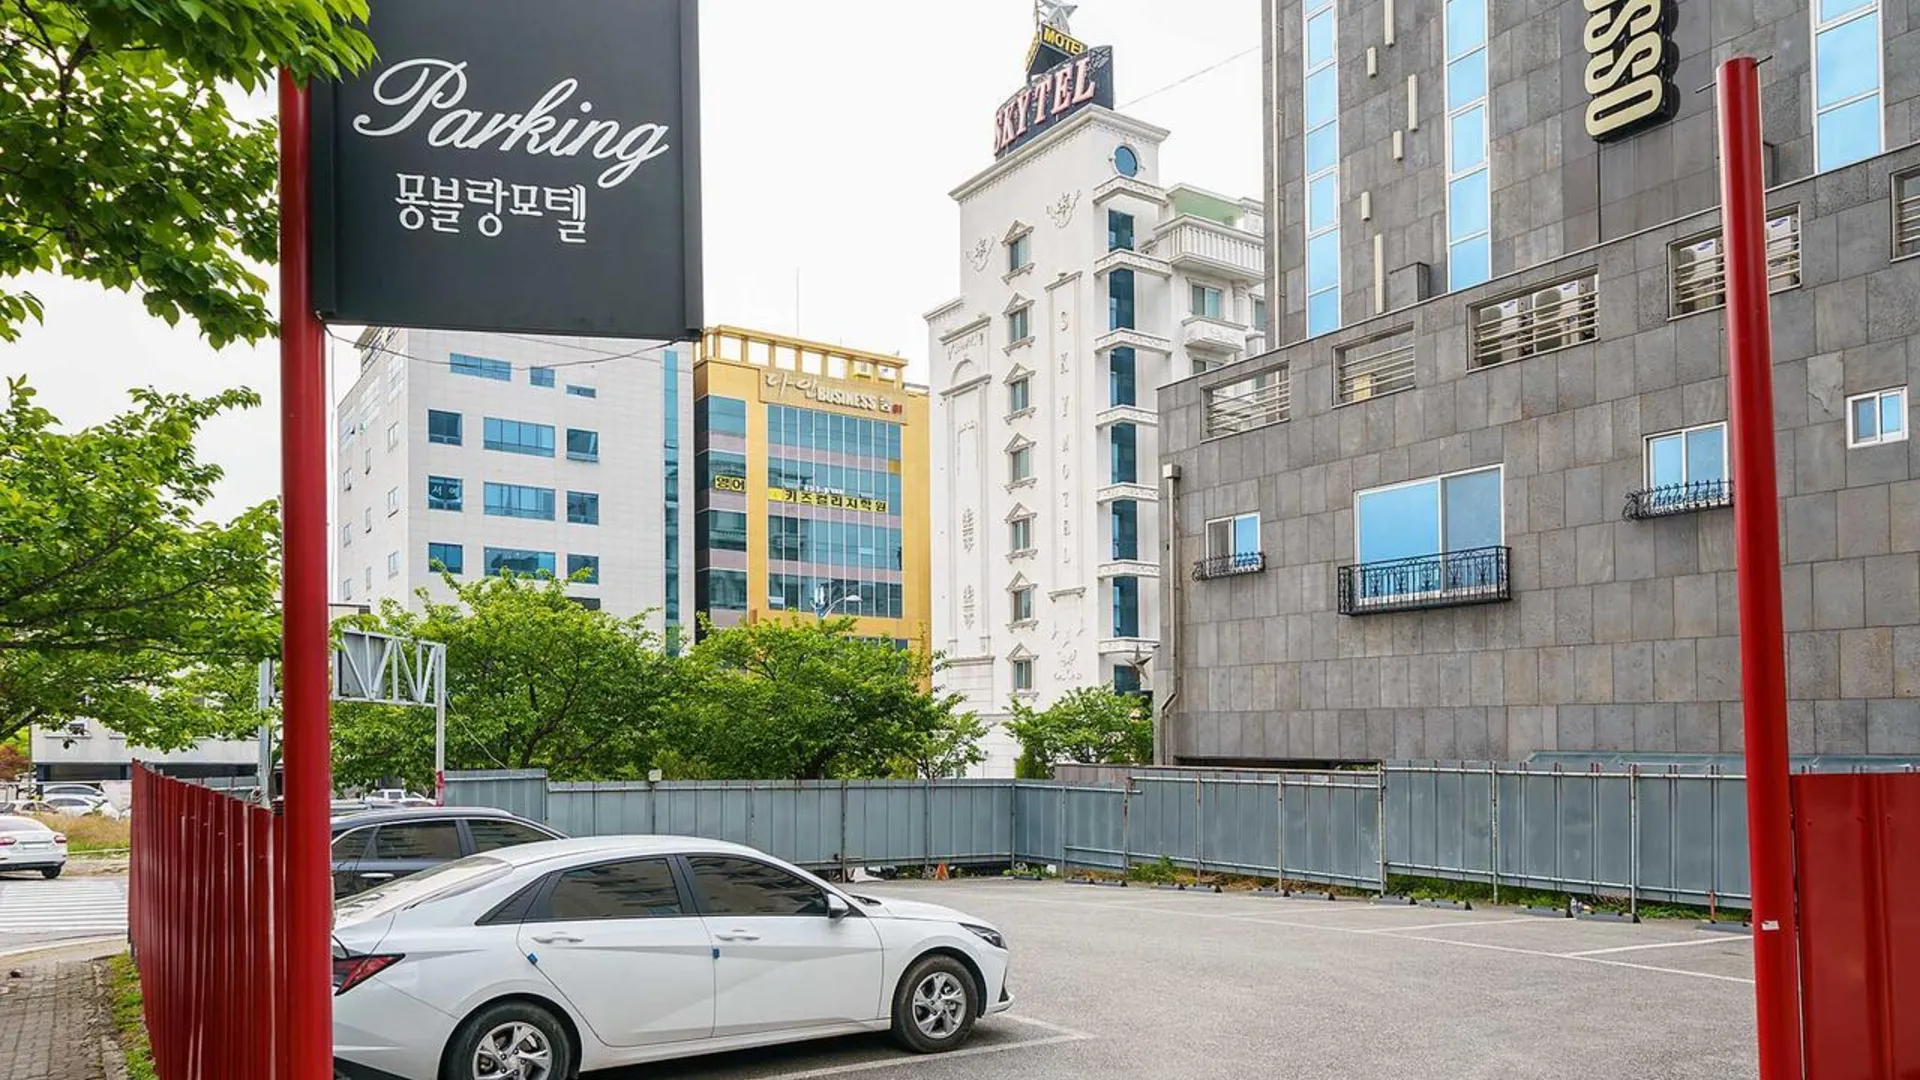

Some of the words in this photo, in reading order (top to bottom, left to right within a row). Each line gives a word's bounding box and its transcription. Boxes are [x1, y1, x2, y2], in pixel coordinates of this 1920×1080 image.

[1043, 26, 1085, 54] MOTEL
[353, 58, 669, 188] Parking
[994, 57, 1096, 155] SKYTEL
[396, 173, 587, 243] 몽블랑모텔
[817, 386, 877, 411] BUSINESS
[716, 476, 745, 490] 영어
